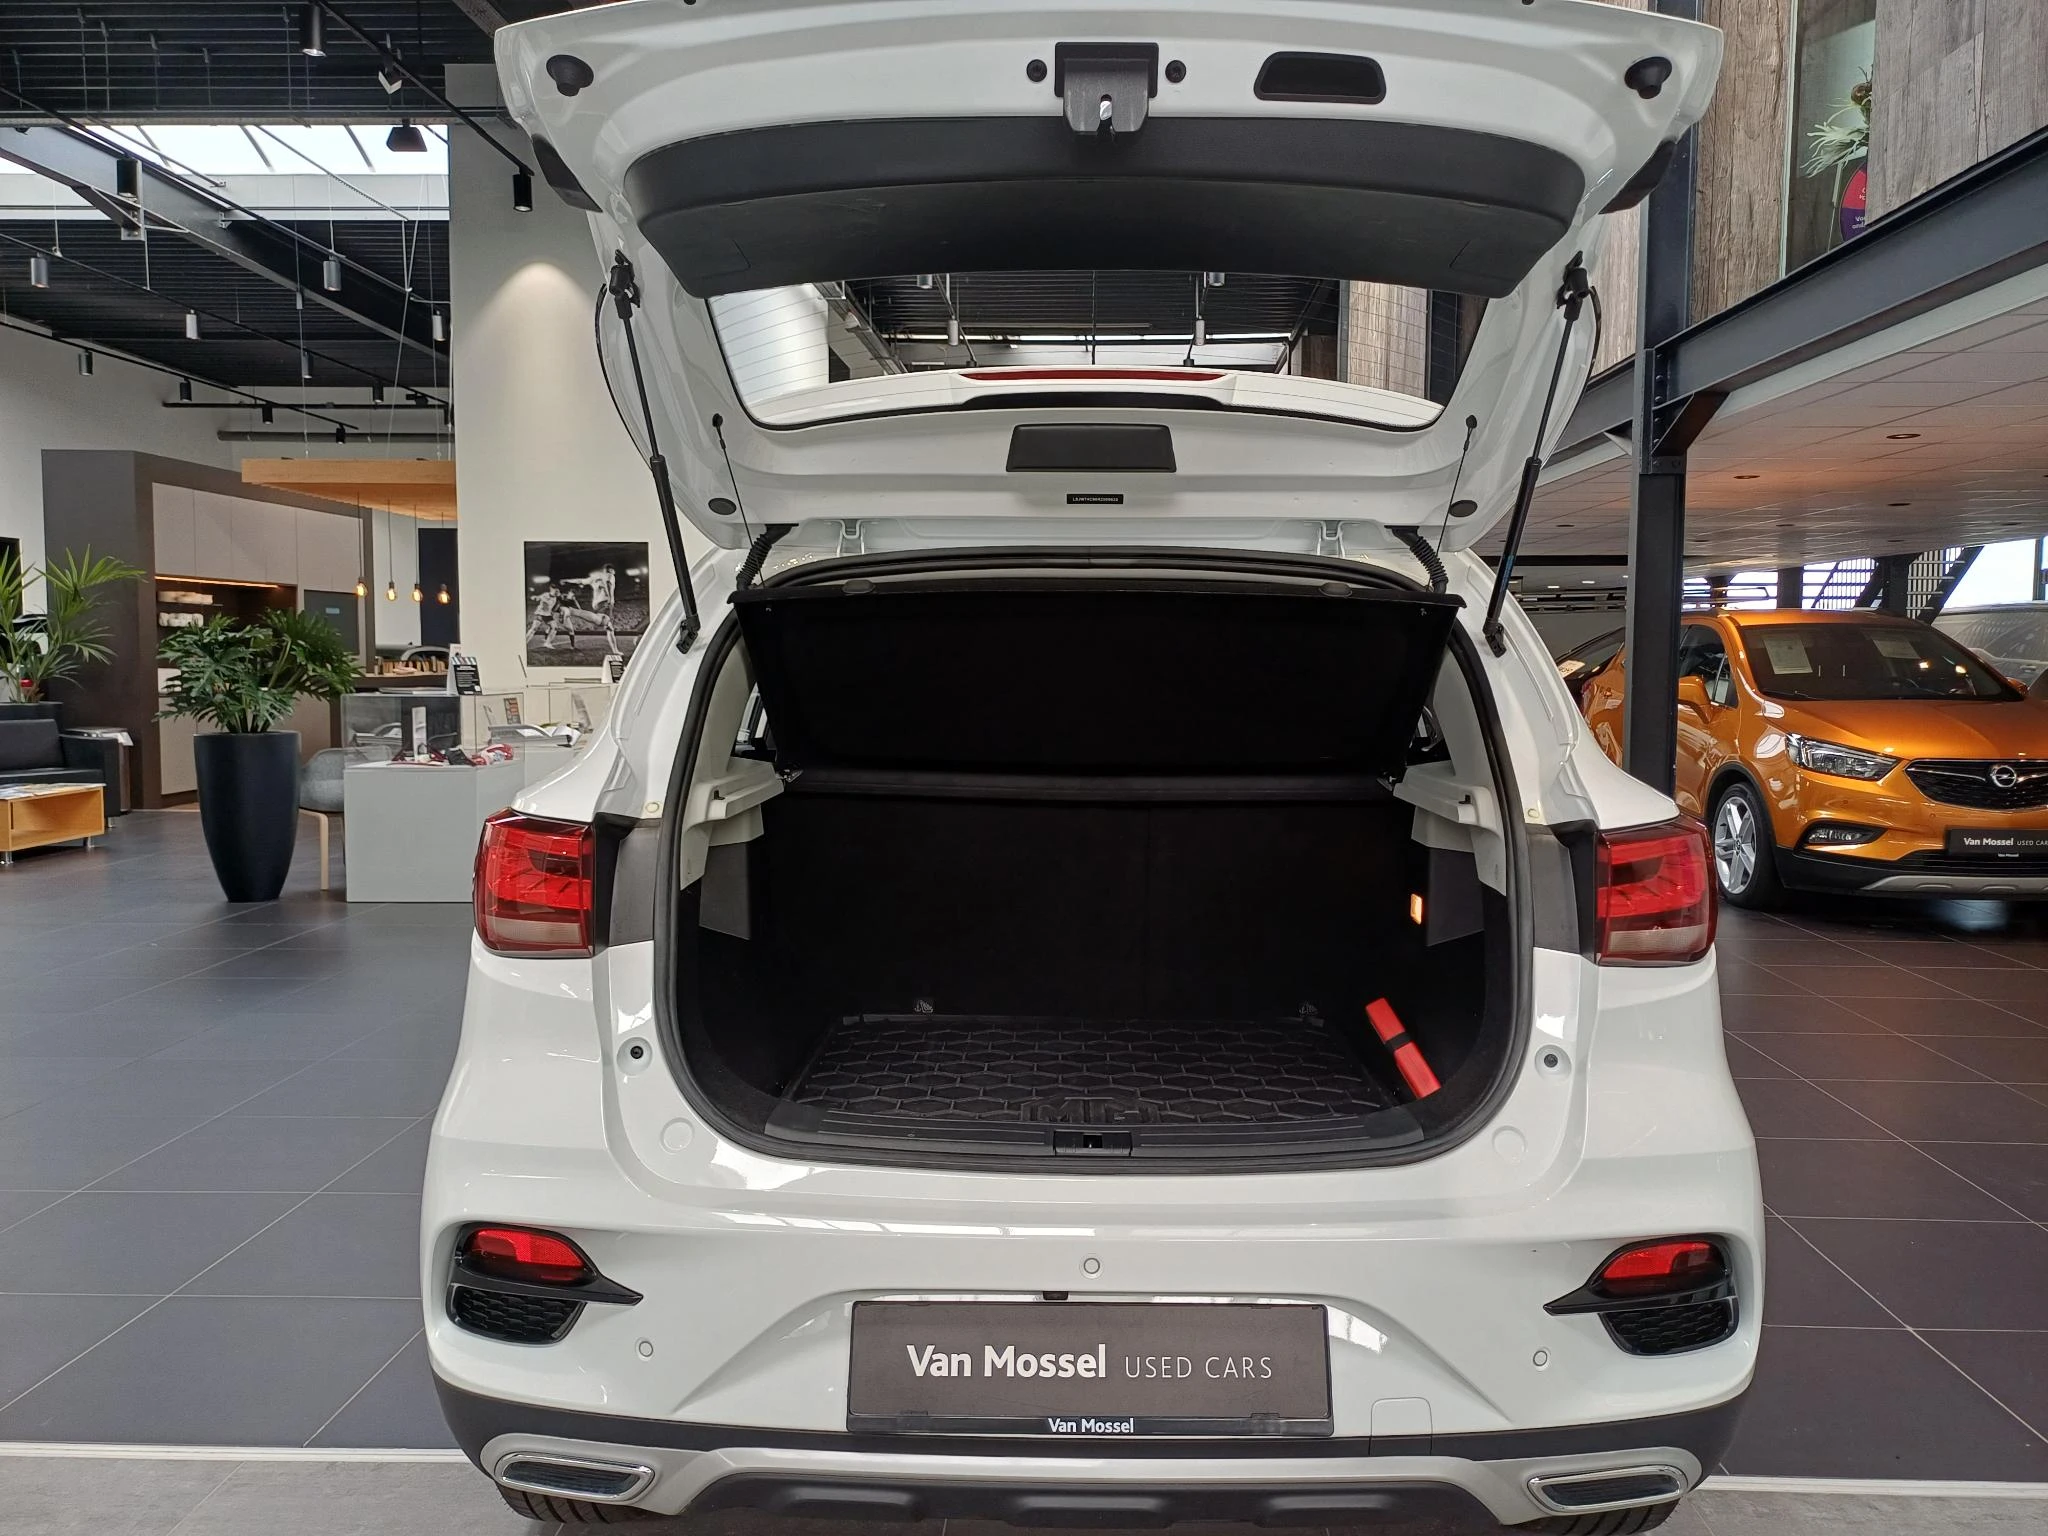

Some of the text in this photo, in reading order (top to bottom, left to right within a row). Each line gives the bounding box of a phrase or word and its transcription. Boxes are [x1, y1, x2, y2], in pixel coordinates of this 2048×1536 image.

[1964, 837, 1981, 846] Van
[1983, 837, 2014, 846] Mossel
[906, 1343, 1272, 1379] Van Mossel USED CARS
[1048, 1417, 1134, 1434] Van Mossel
